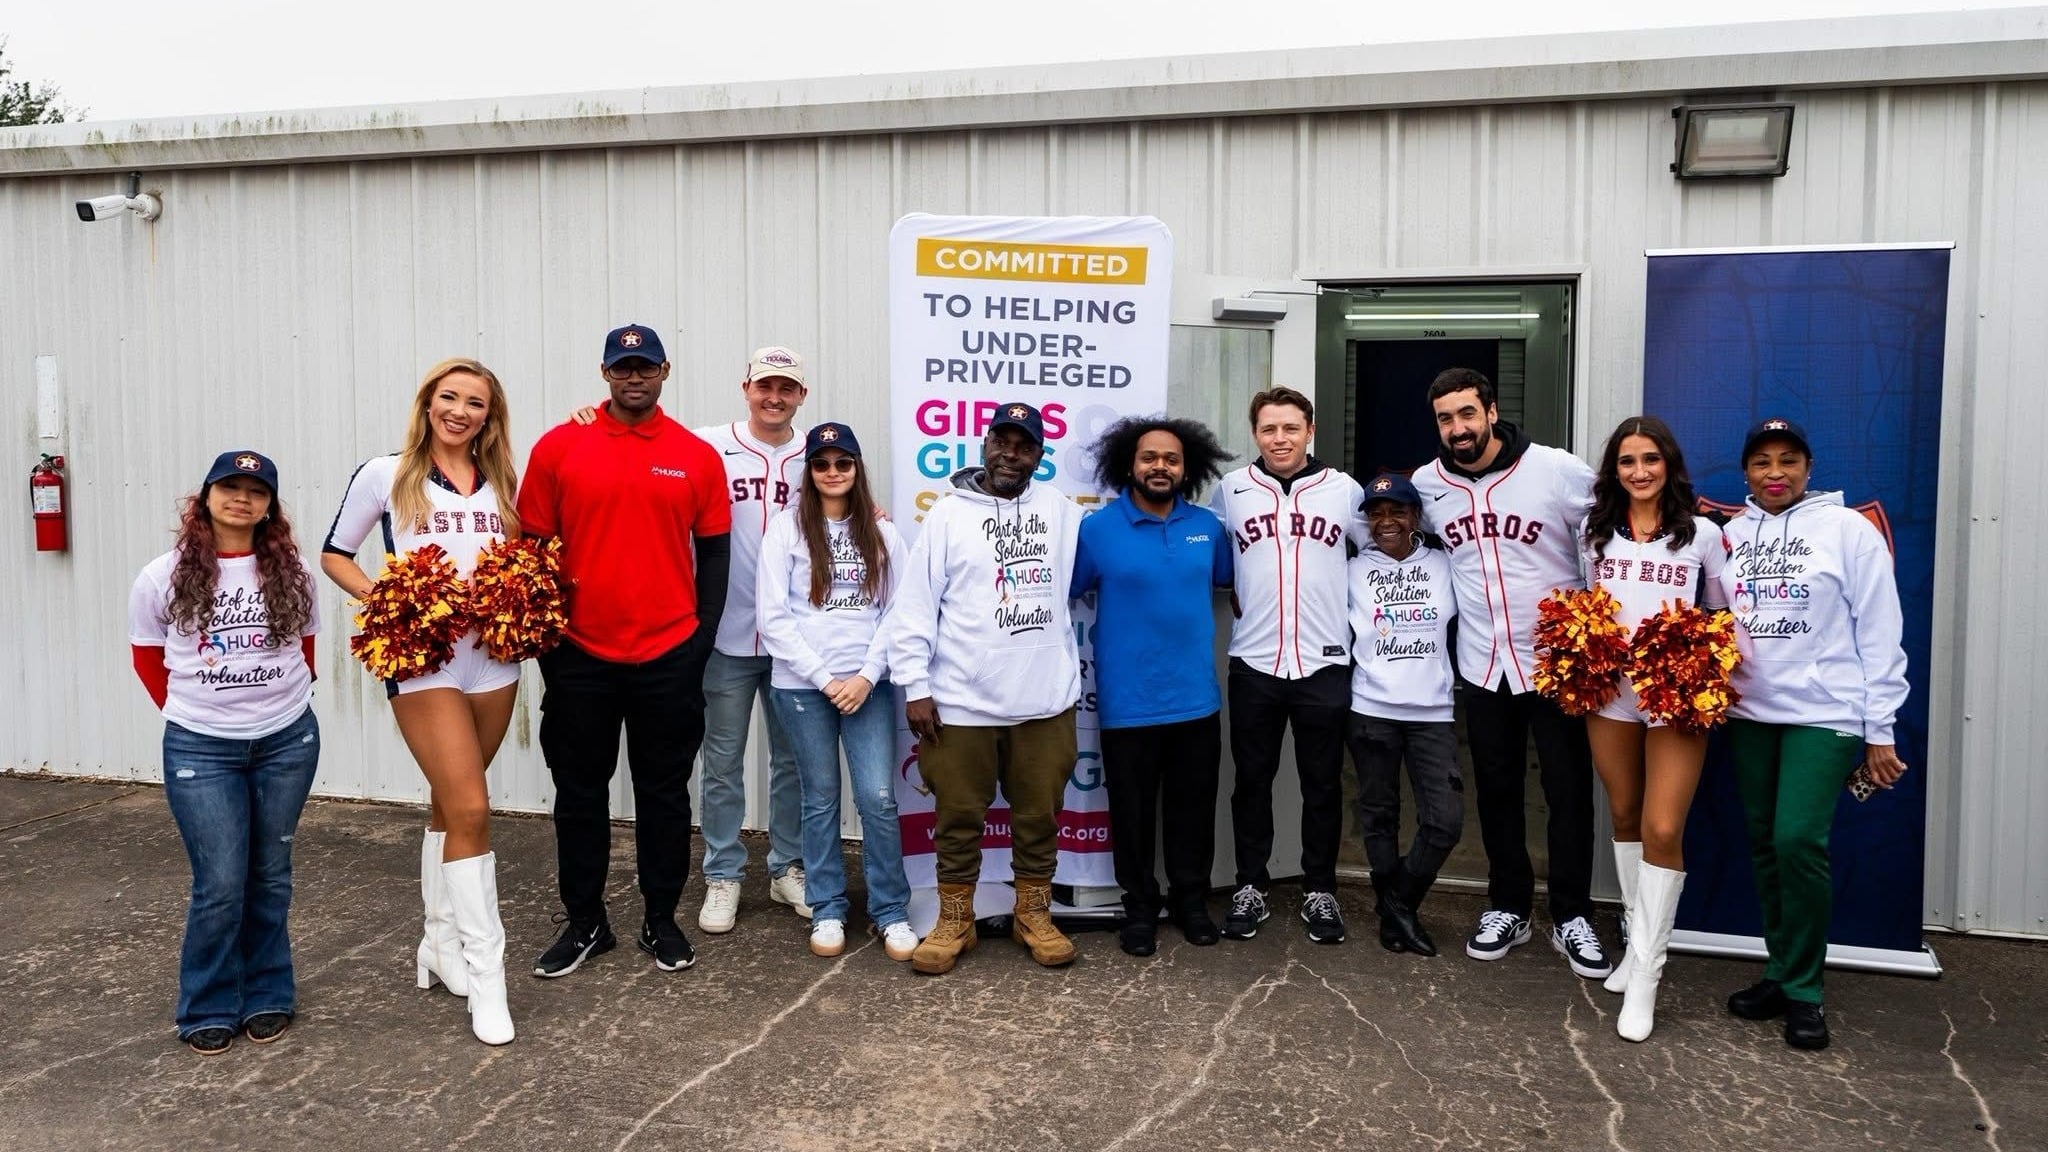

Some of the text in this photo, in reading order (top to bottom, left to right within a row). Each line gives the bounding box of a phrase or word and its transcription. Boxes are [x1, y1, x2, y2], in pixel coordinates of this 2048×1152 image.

[935, 247, 1128, 277] COMMITTED
[923, 293, 1137, 325] TO HELPING
[962, 330, 1097, 358] UNDER-
[925, 358, 1132, 389] PRIVILEGED
[415, 511, 504, 535] ASTRO
[983, 513, 1048, 542] Part of the
[1235, 513, 1342, 555] ASTROS
[995, 538, 1048, 563] Solution
[1780, 537, 1813, 556] the
[833, 568, 867, 581] HUGG
[1015, 568, 1052, 585] HUGGS
[1367, 566, 1431, 589] Part of the
[1736, 558, 1806, 578] Solution
[1374, 585, 1431, 604] Solution
[1758, 583, 1810, 599] HUGGS
[211, 607, 267, 627] olutio
[995, 603, 1053, 629] Volunteer
[1394, 607, 1438, 622] HUGGS
[1375, 636, 1437, 656] Volunteer
[196, 665, 284, 685] Volunteer
